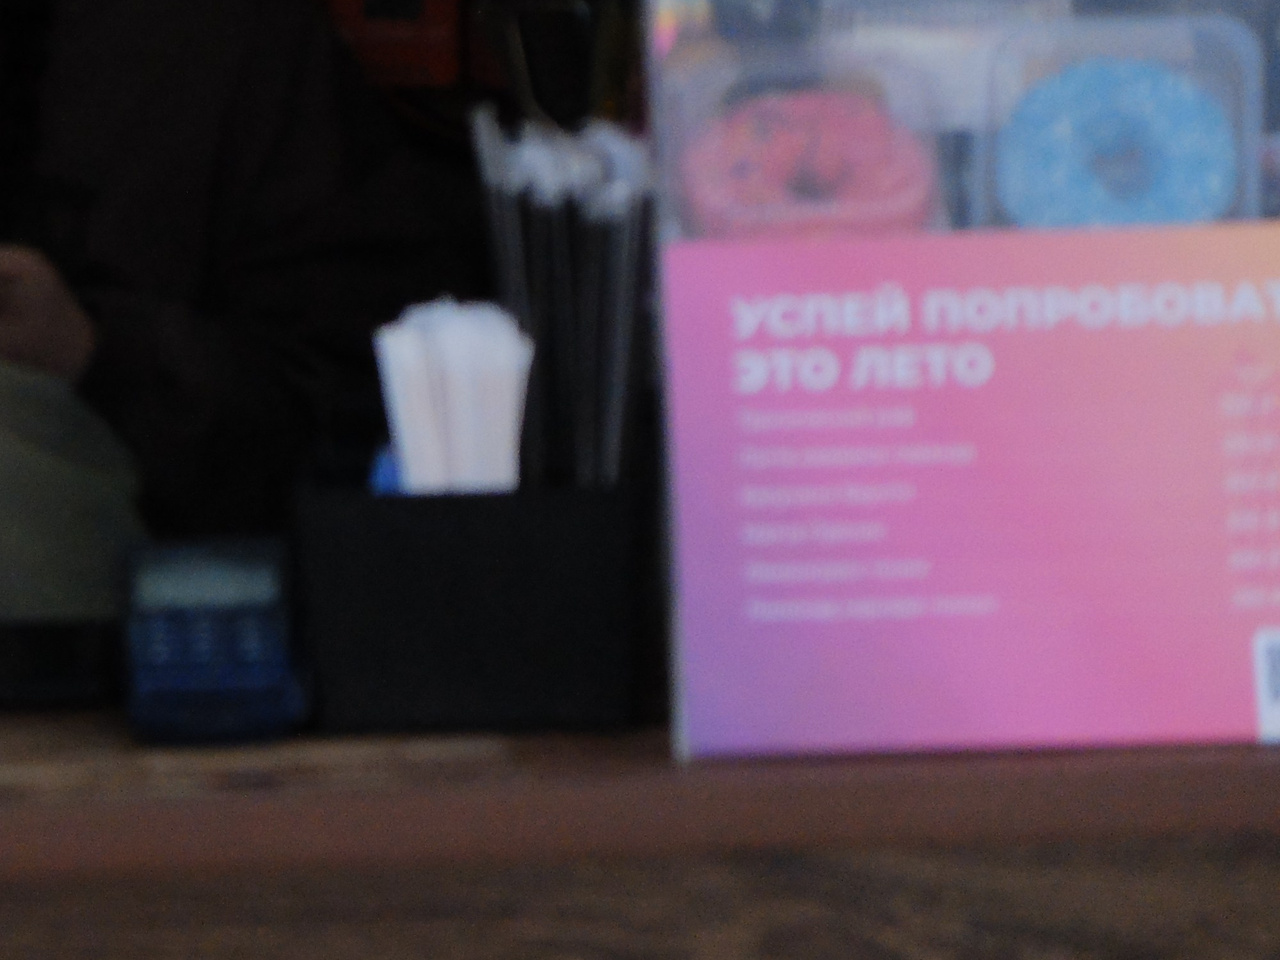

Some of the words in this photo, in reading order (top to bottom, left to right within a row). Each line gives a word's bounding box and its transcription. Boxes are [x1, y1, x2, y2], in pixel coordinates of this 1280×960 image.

[732, 283, 911, 339] УСПЕЙ
[734, 346, 841, 394] ЭТО
[851, 341, 995, 390] ЛЕТО
